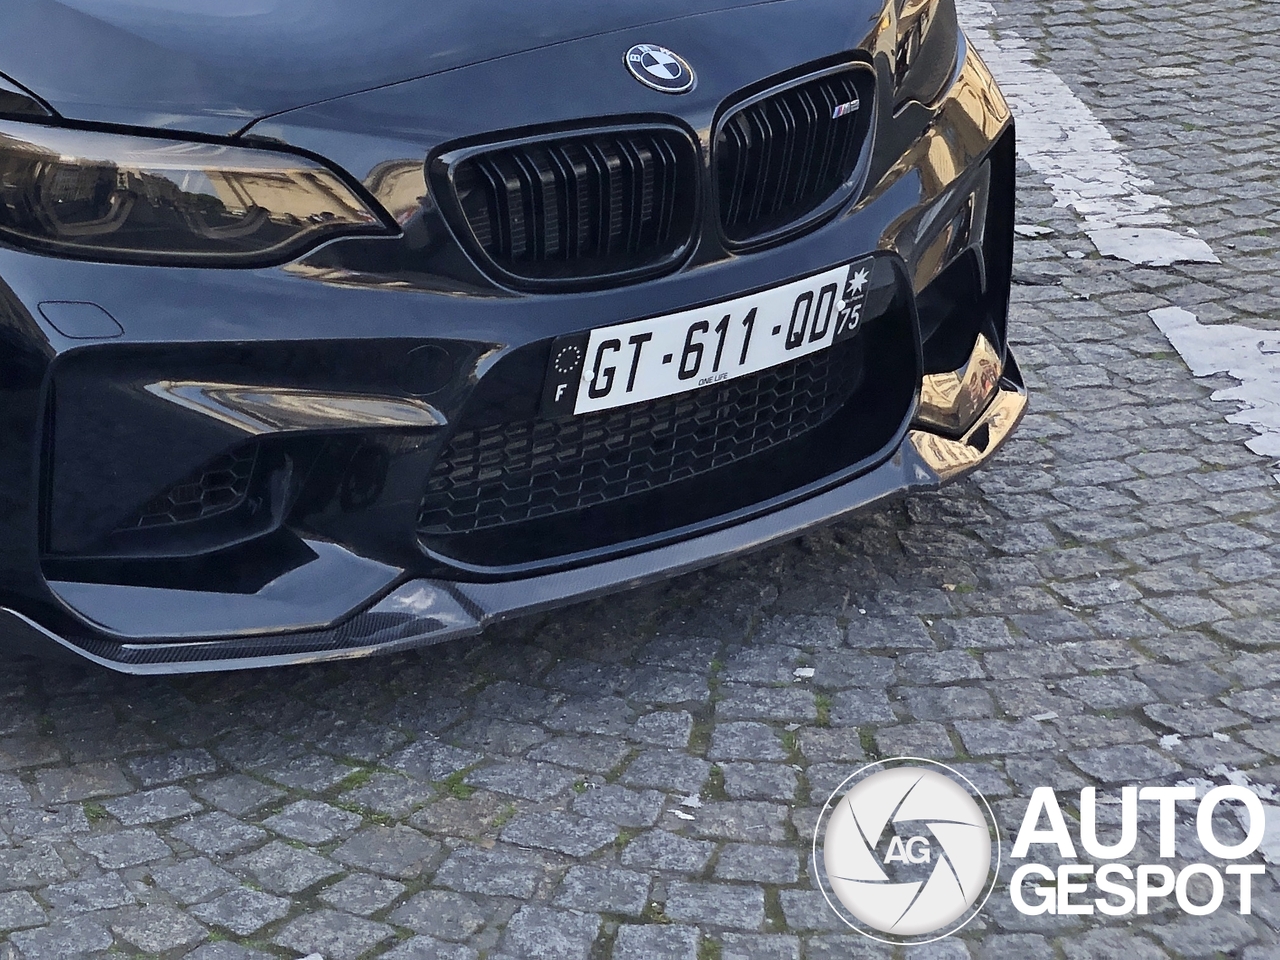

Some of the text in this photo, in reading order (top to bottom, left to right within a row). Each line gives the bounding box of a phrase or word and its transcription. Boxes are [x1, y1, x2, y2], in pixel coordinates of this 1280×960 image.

[837, 304, 862, 335] 75
[698, 372, 729, 387] ONE LIFE
[554, 383, 568, 403] F
